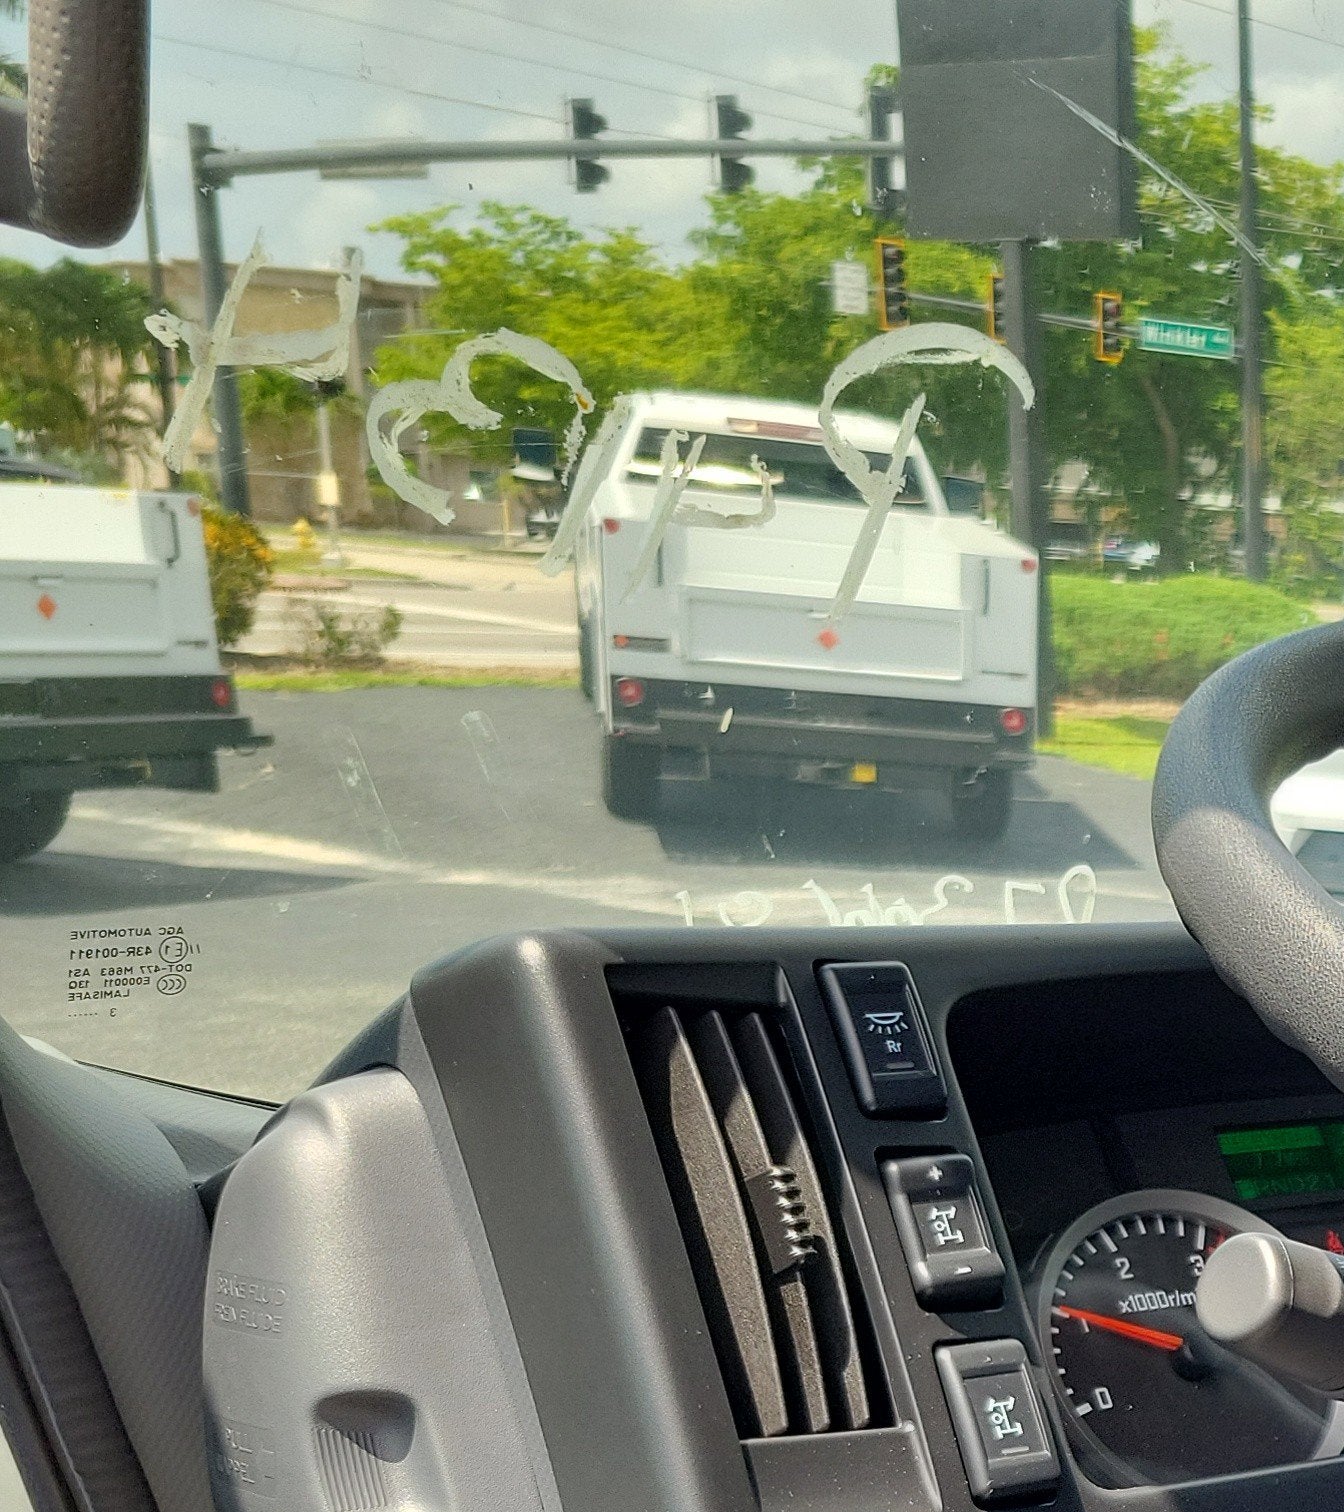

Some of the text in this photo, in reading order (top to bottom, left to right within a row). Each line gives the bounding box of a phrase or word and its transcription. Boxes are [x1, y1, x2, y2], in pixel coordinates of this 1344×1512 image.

[886, 1040, 902, 1053] Rr
[1115, 1257, 1134, 1280] 2
[1190, 1254, 1205, 1277] 3
[1094, 1387, 1113, 1409] 0
